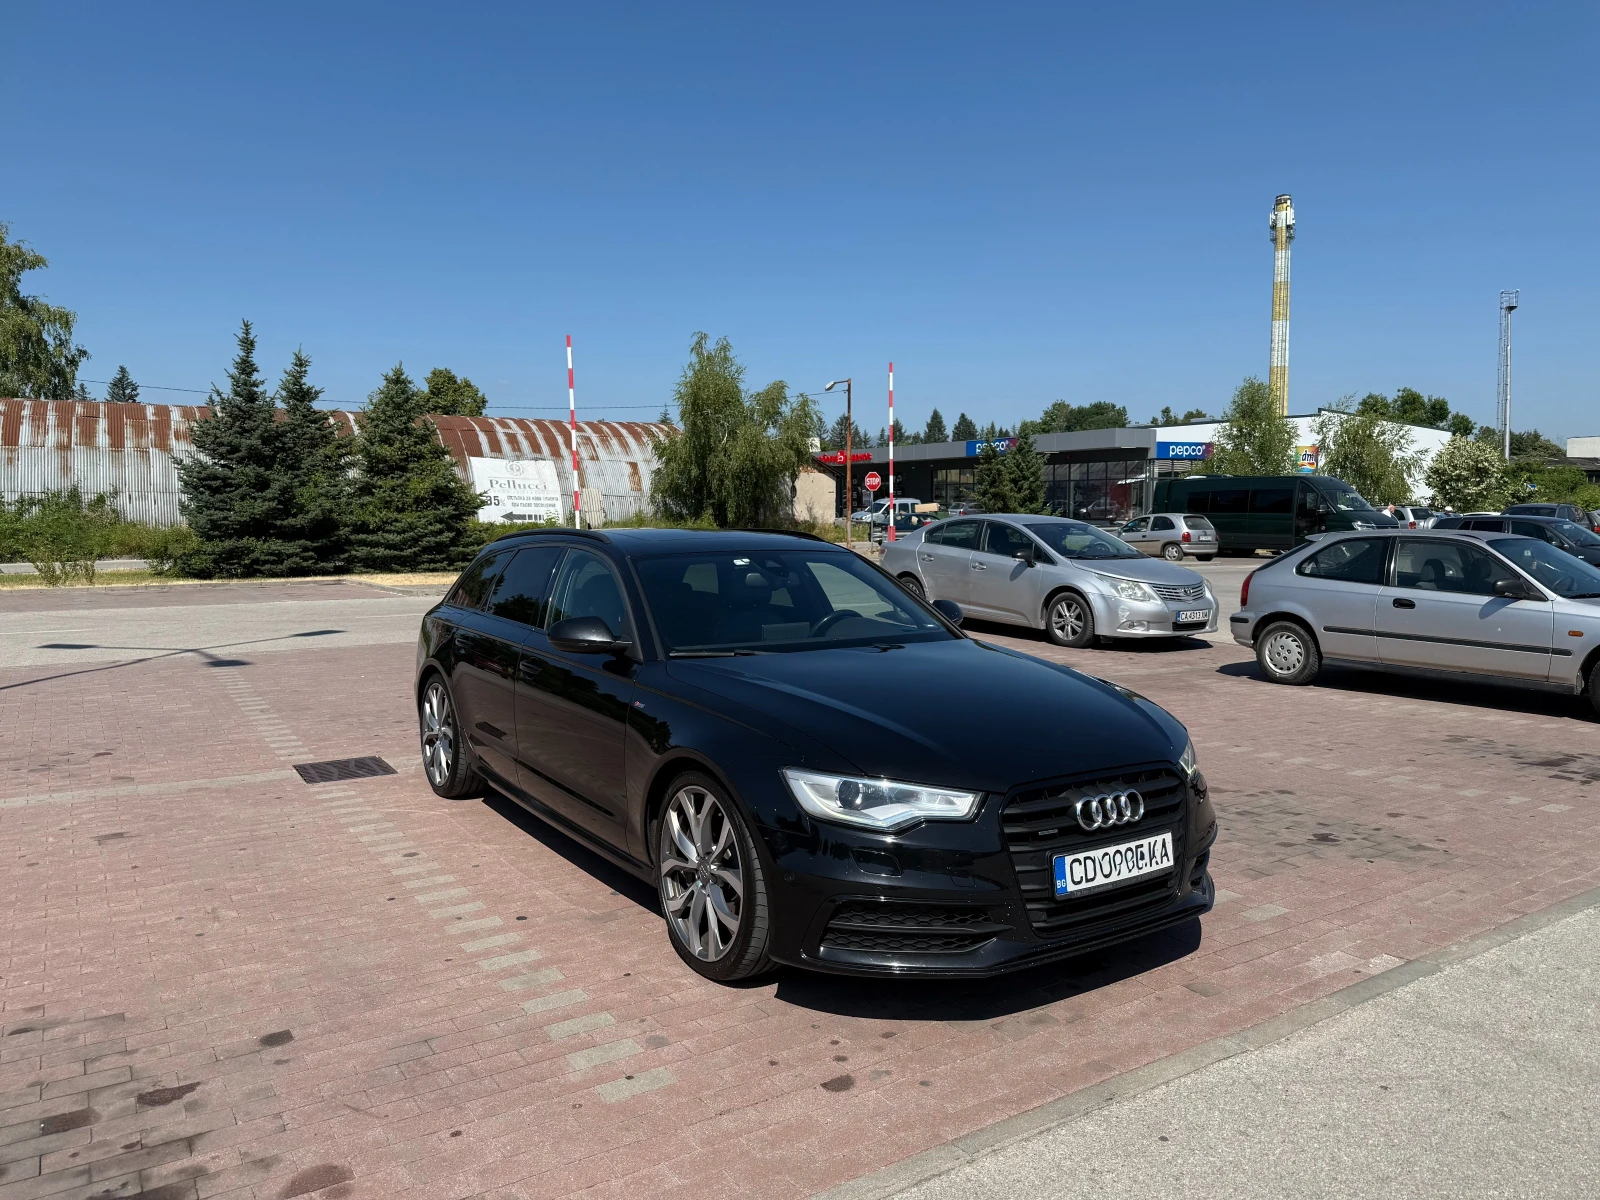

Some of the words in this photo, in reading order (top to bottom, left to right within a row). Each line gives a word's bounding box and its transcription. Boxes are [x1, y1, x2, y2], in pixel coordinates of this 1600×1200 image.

[1169, 445, 1203, 458] pepco
[1302, 449, 1315, 461] dm
[489, 479, 547, 490] Pellucci
[866, 478, 880, 486] STOP
[1056, 879, 1066, 889] BG
